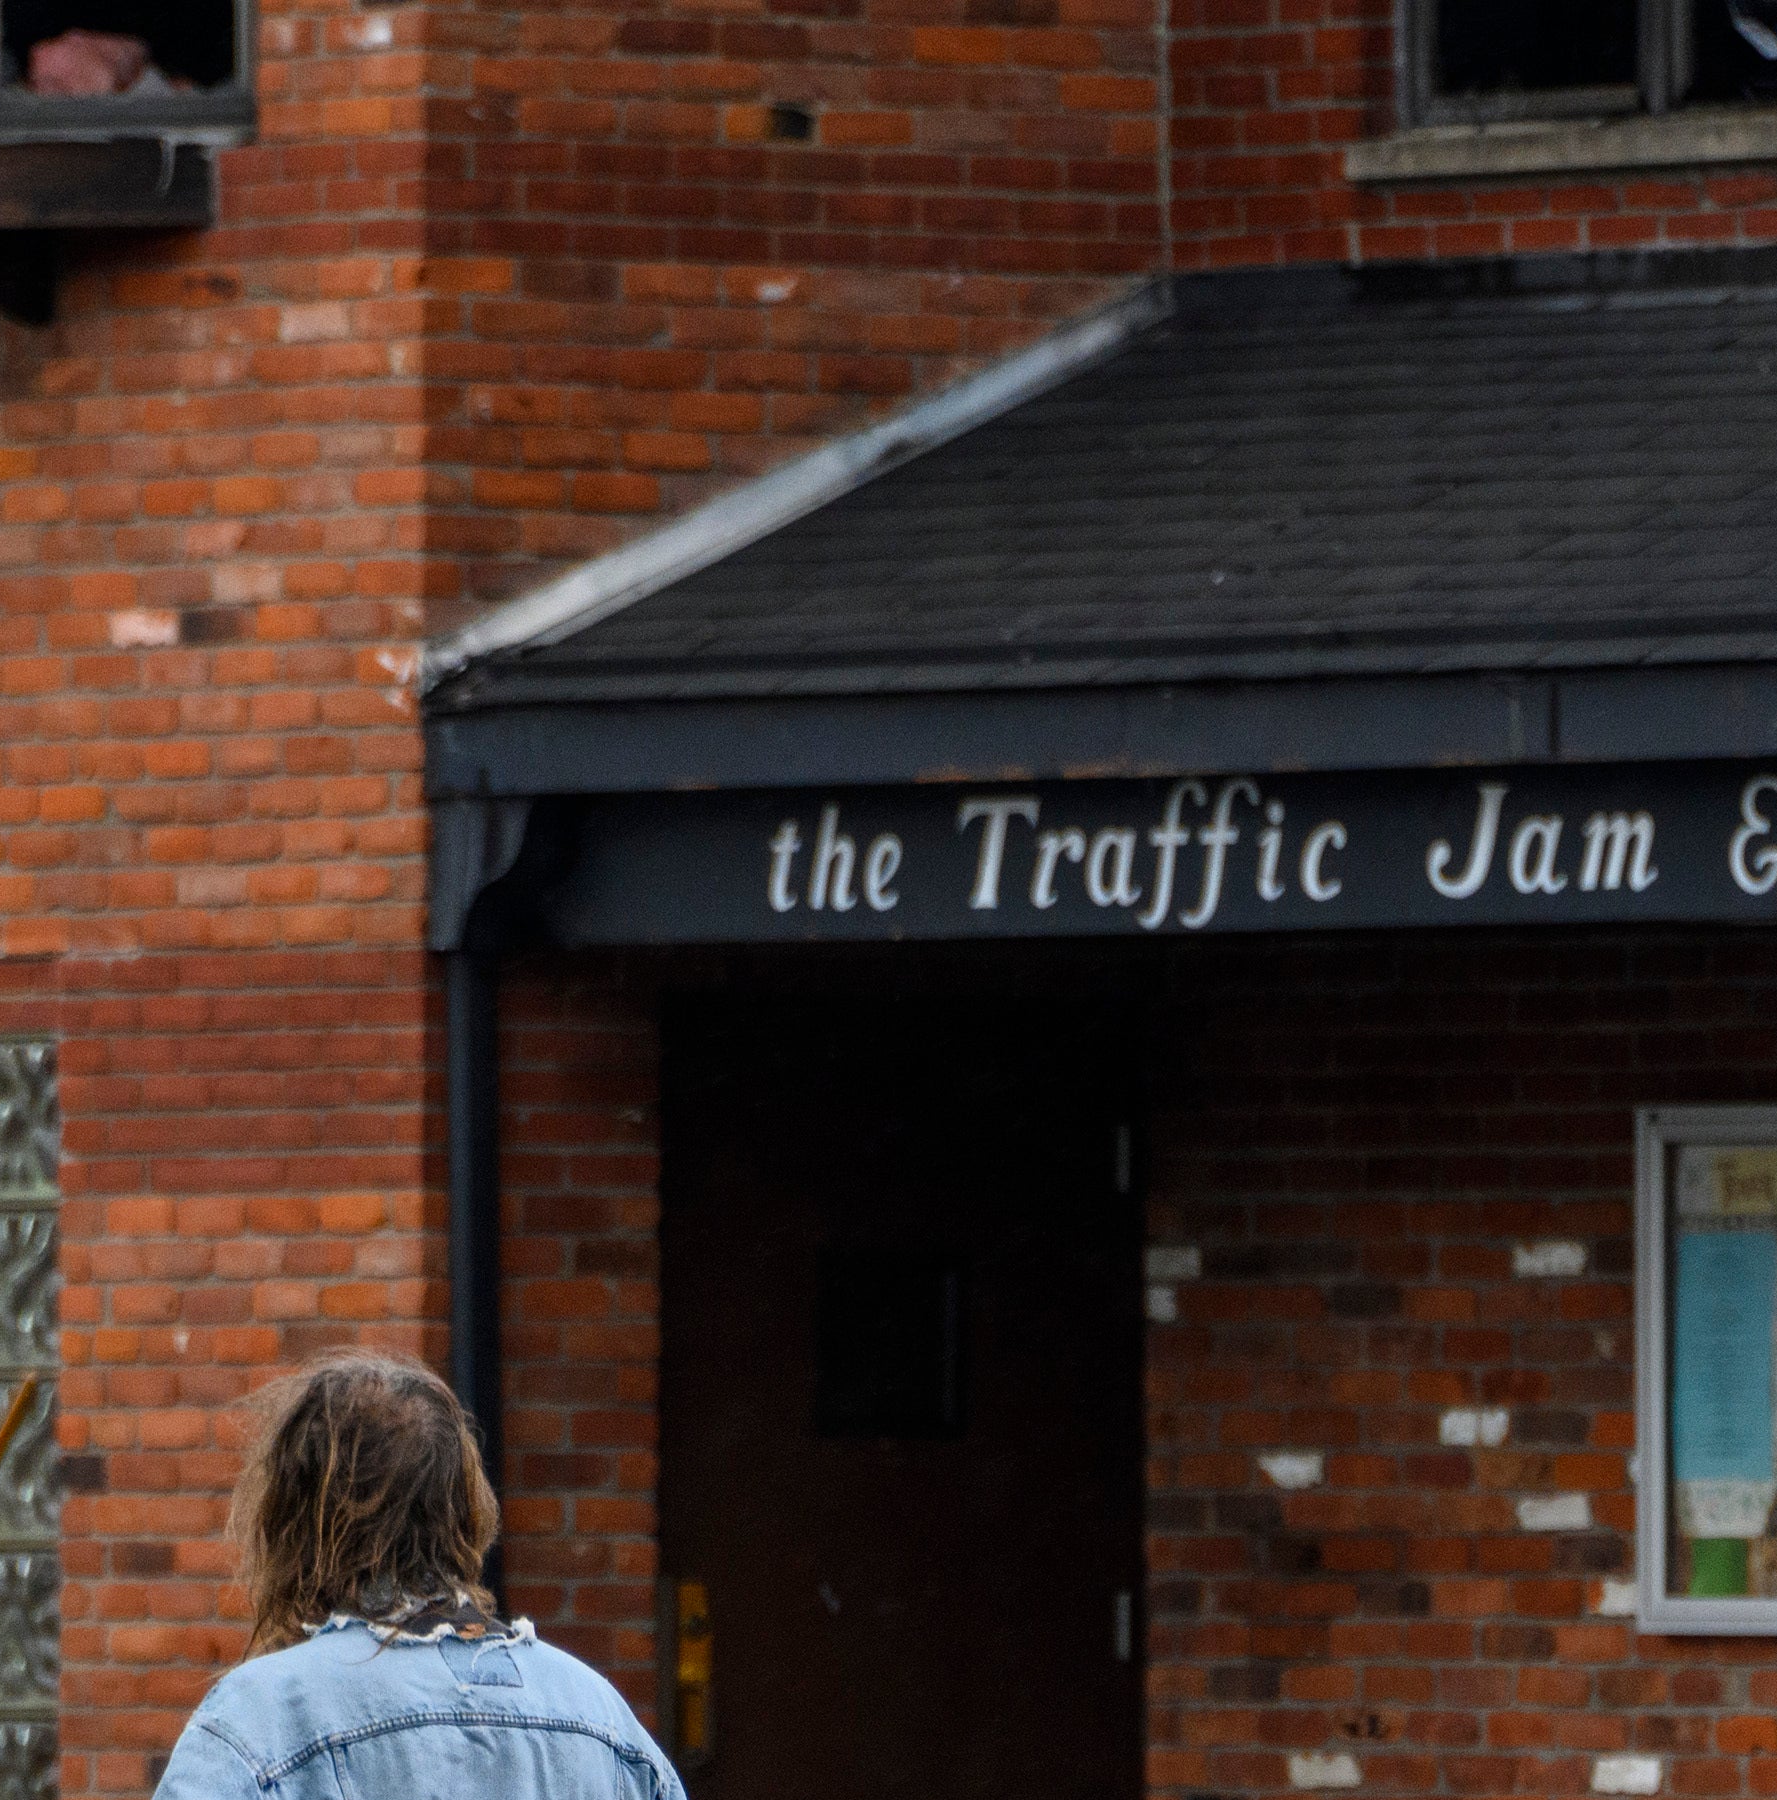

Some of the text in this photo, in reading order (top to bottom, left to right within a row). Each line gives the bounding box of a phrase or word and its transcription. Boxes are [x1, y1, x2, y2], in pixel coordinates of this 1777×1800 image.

[767, 804, 904, 912] the
[956, 778, 1348, 930] Traffic
[1426, 781, 1660, 900] Jam
